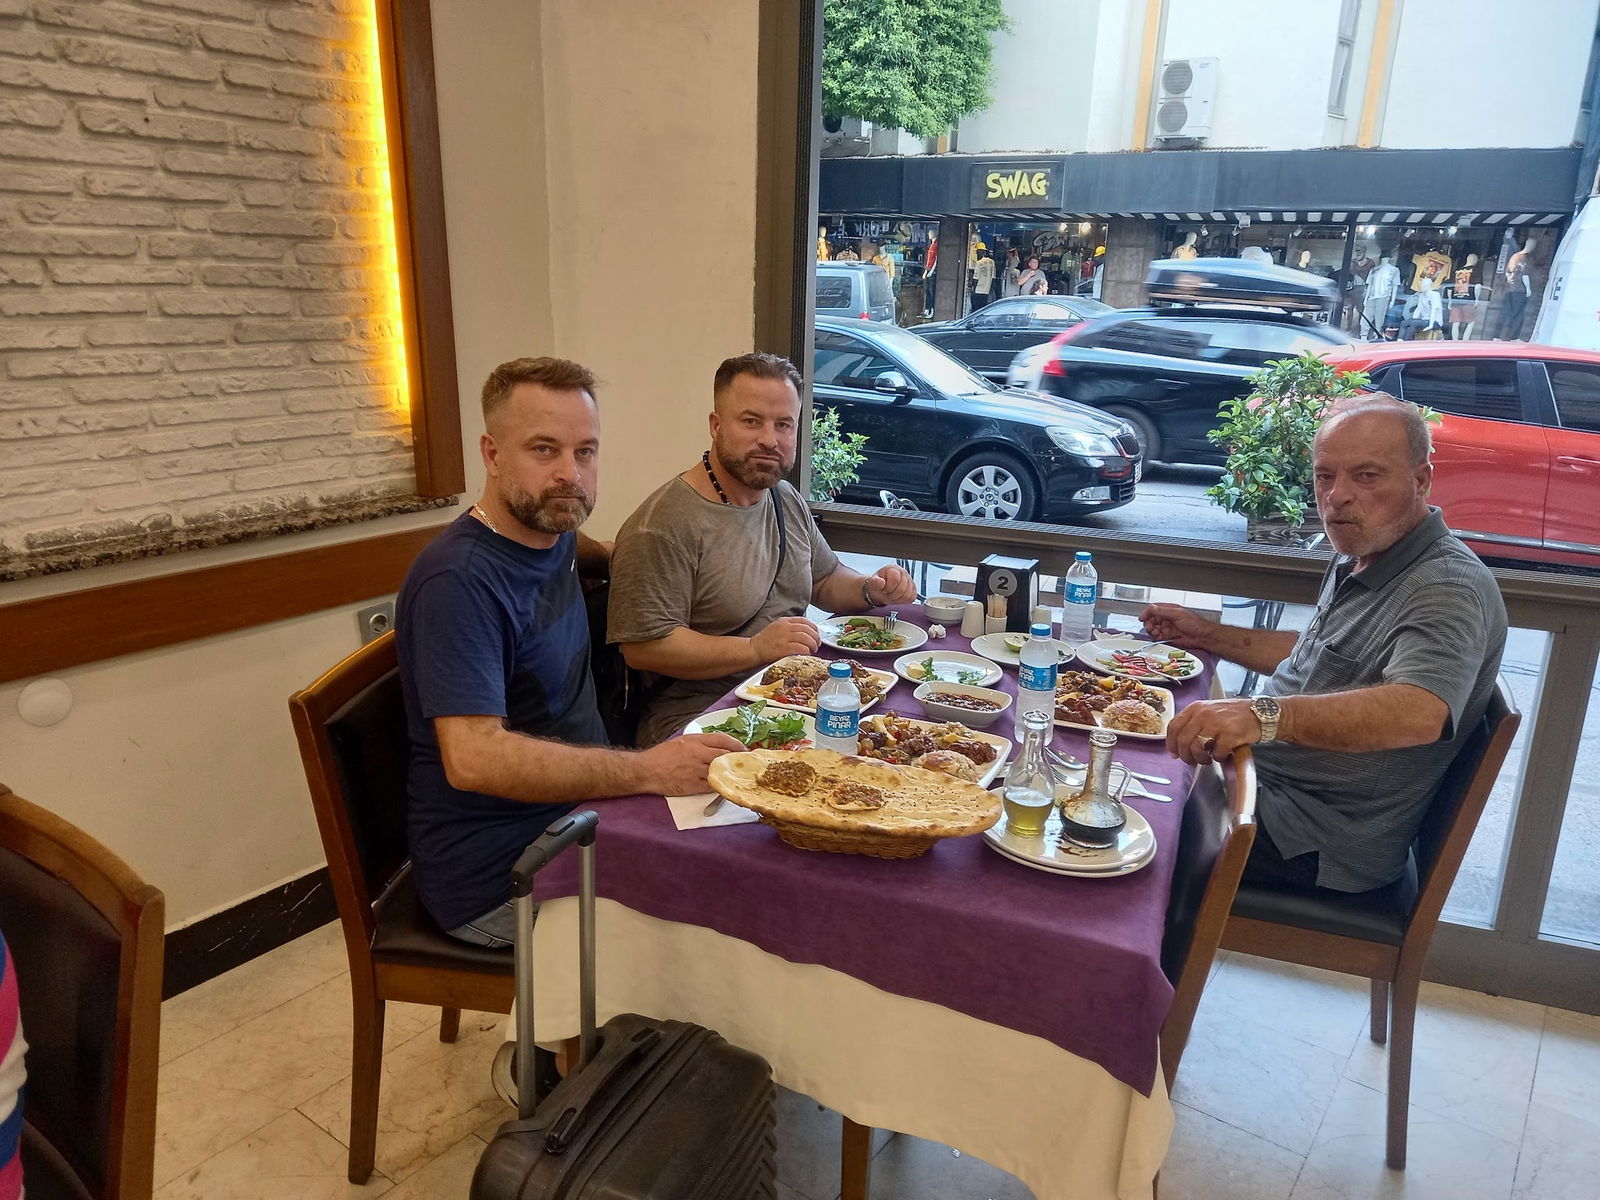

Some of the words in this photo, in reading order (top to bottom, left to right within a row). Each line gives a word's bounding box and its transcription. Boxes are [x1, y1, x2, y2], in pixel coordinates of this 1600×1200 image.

[986, 170, 1047, 199] SWAG
[997, 576, 1009, 590] 2
[827, 720, 851, 729] PINAR
